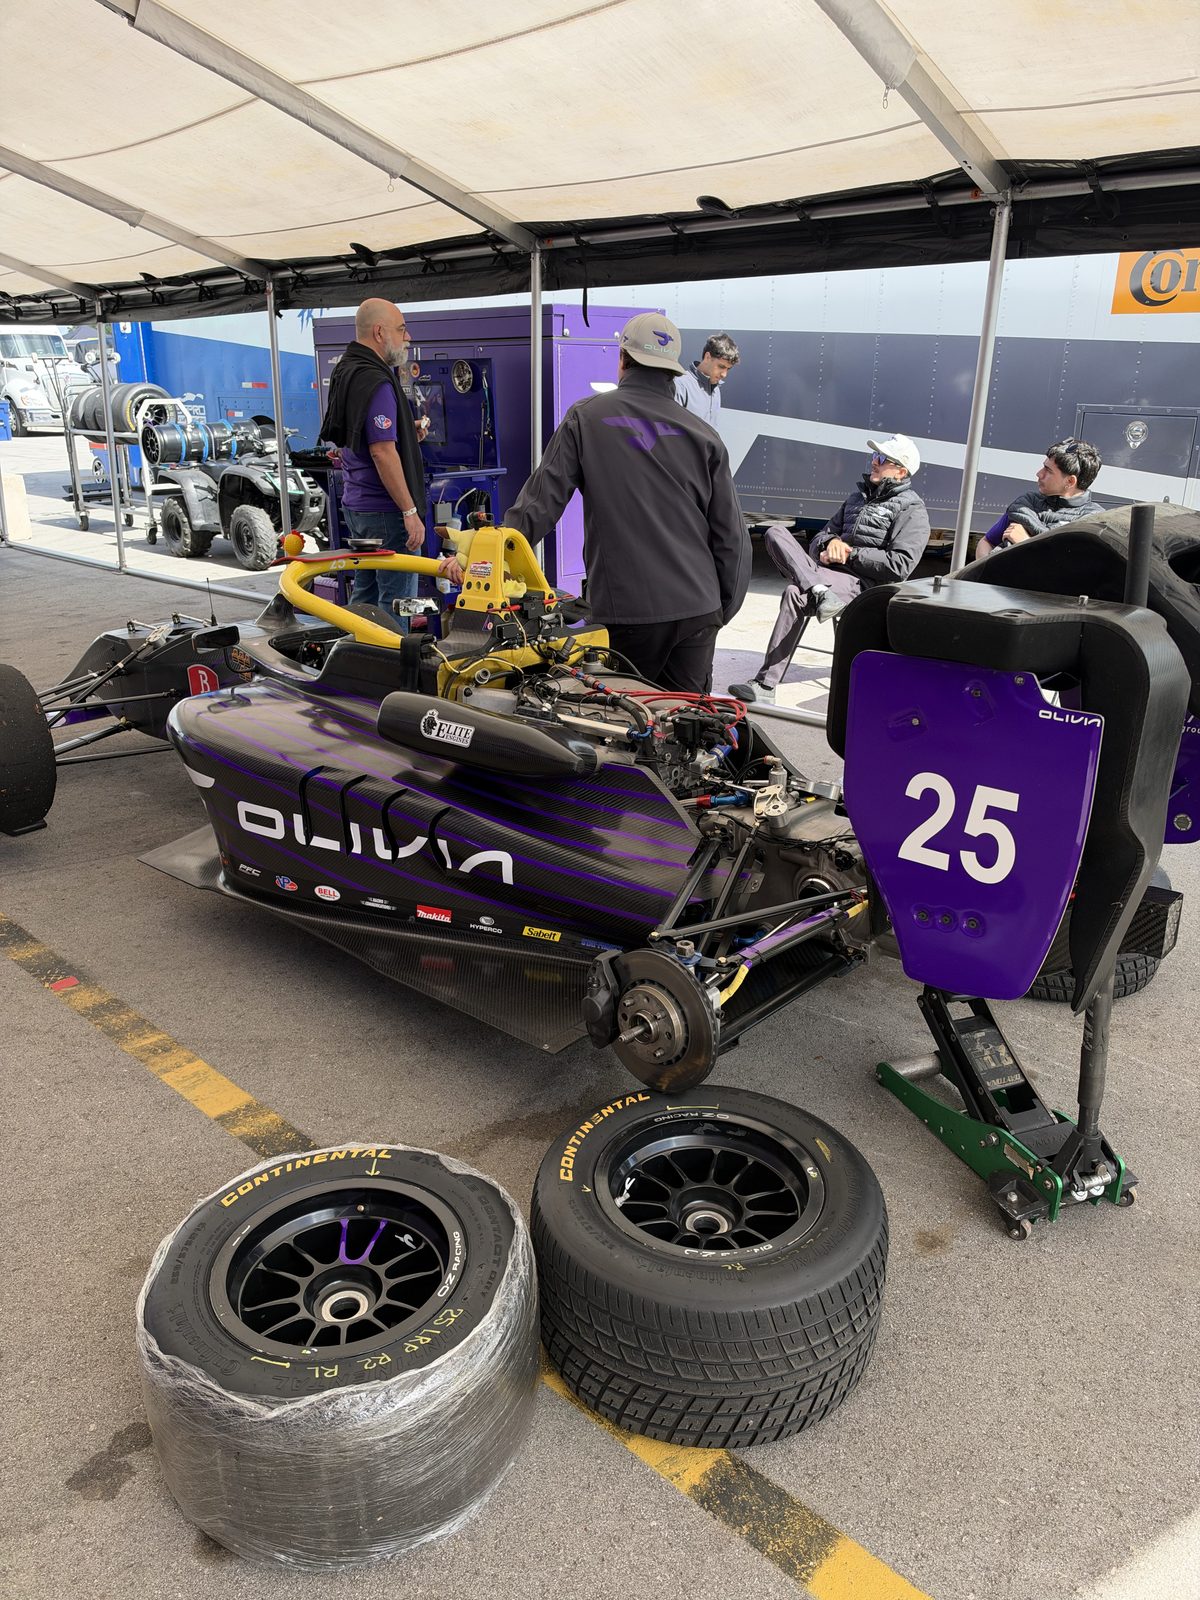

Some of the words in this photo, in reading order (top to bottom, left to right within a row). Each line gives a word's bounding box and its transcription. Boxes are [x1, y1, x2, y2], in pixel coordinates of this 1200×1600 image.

[1038, 709, 1101, 728] OLIVIA
[435, 721, 473, 739] ELITE
[897, 771, 1020, 885] 25
[317, 887, 338, 898] BELL
[469, 923, 503, 935] HYPERCO
[526, 927, 557, 941] Sabelt
[653, 1112, 699, 1123] RACING
[559, 1092, 651, 1182] CONTINENTAL
[220, 1148, 393, 1208] CONTINENTAL
[451, 1231, 462, 1271] RACING
[356, 1352, 392, 1370] R2
[307, 1364, 339, 1379] RL
